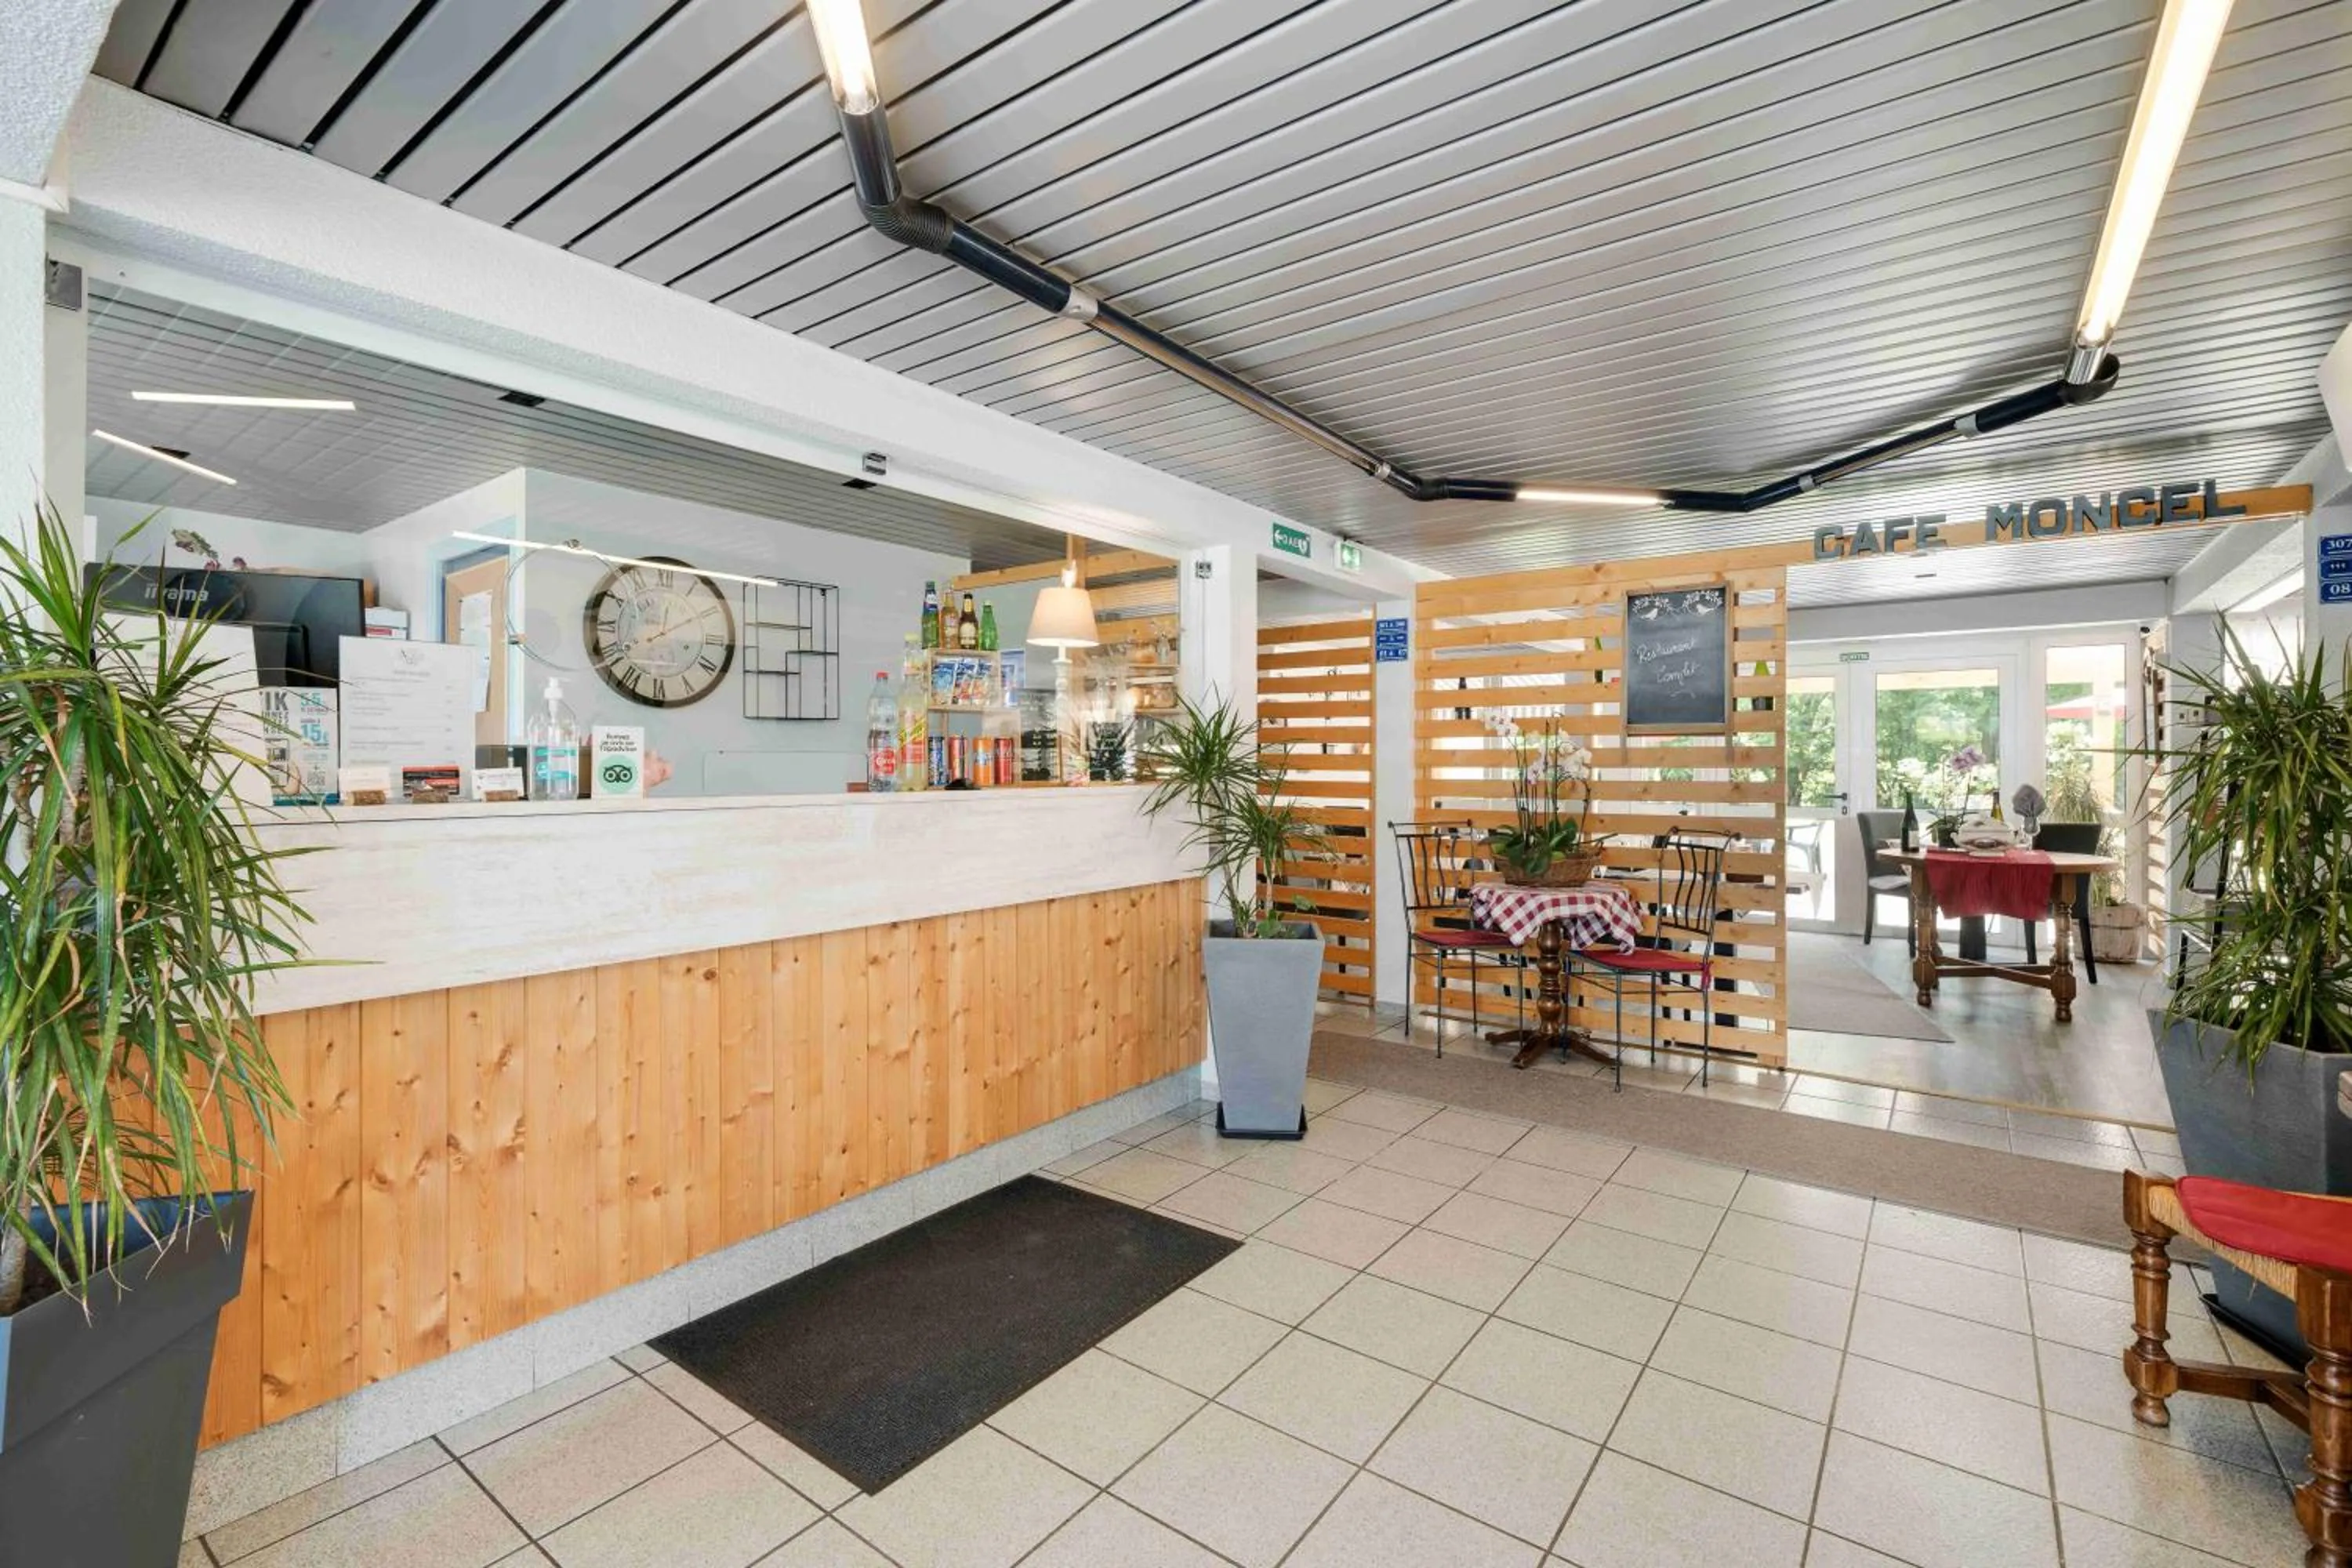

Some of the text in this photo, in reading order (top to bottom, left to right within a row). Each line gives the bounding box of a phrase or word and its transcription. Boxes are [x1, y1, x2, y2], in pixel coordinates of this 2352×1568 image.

[144, 583, 209, 602] iiama
[2329, 583, 2350, 595] 08
[260, 691, 289, 711] IK
